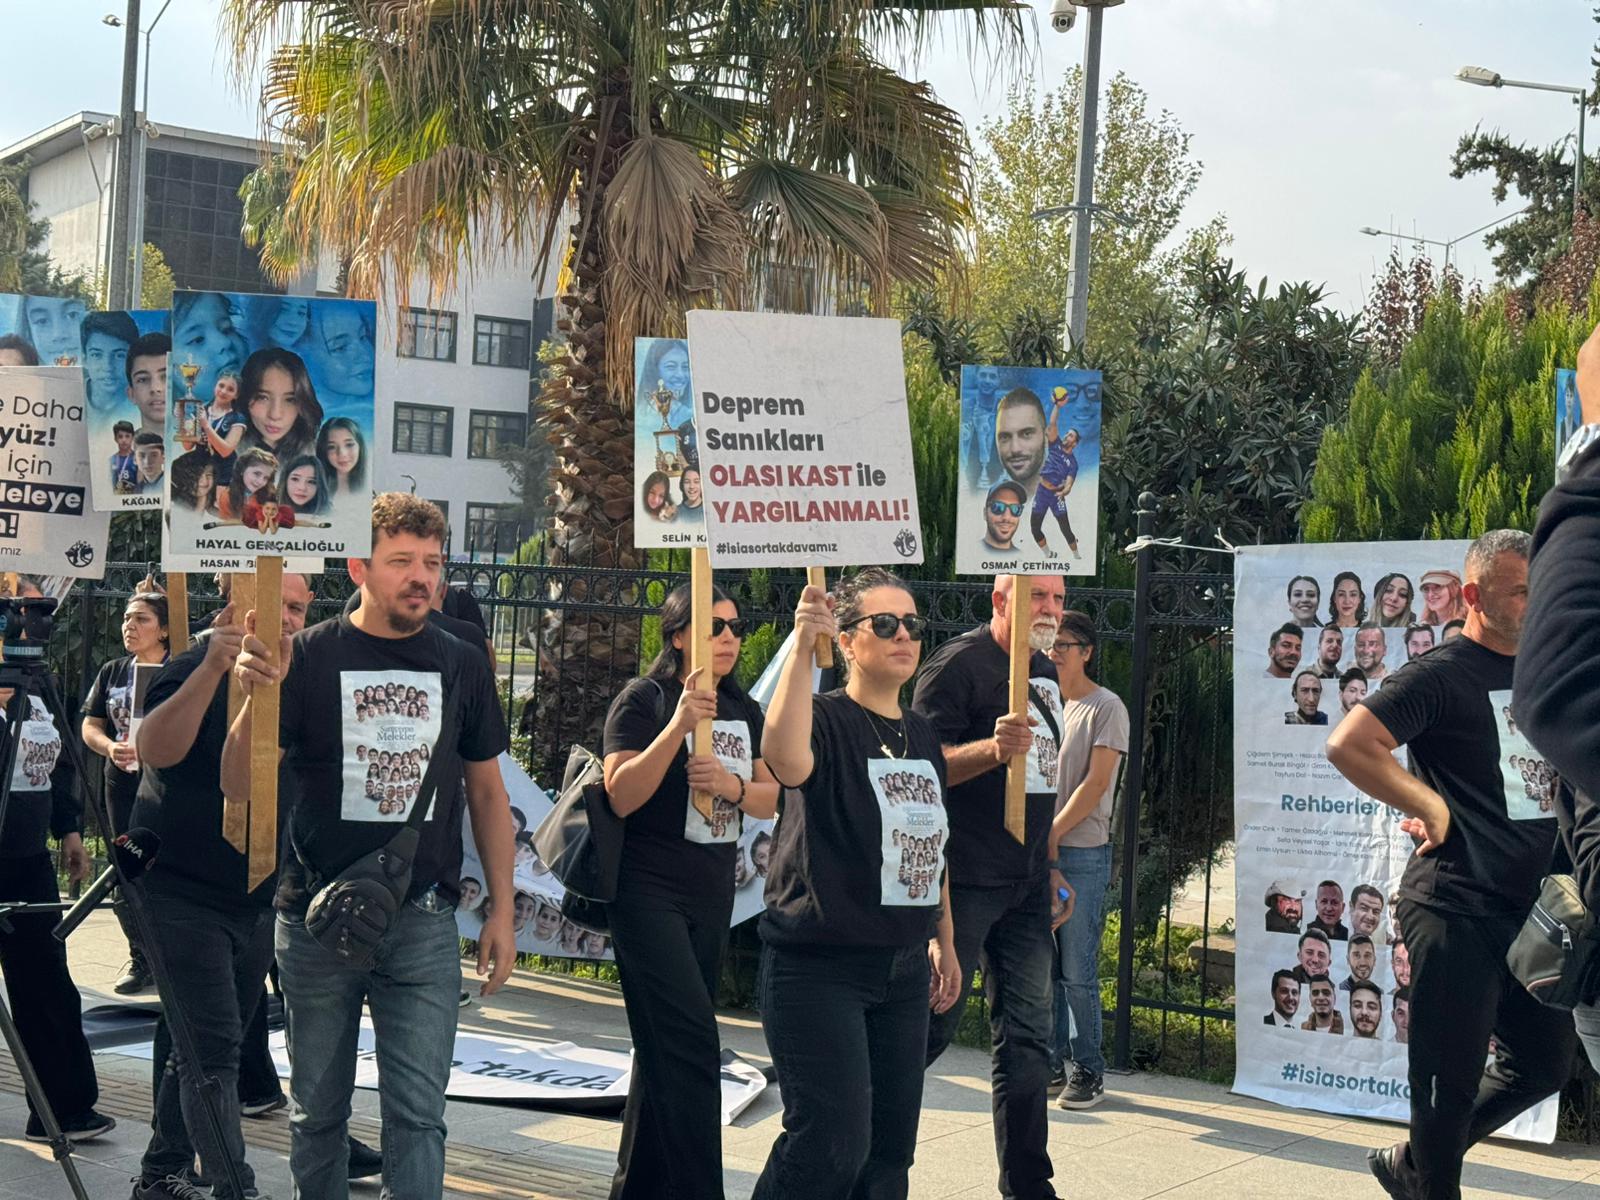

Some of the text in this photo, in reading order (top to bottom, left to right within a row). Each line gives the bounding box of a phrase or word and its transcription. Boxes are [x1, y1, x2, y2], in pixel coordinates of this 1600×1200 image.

[13, 396, 84, 422] Daha
[702, 391, 805, 422] Deprem
[705, 427, 825, 451] Sanıkları
[8, 449, 52, 480] İçin
[709, 462, 887, 487] OLASI KAST ile
[711, 499, 911, 523] YARGILANMALI!
[195, 539, 345, 553] HAYAL GENÇALİOĞLU
[662, 530, 692, 543] SELİN
[716, 542, 838, 555] #isiasortakdavamız
[200, 559, 240, 568] HASAN
[981, 559, 1071, 572] OSMAN ÇETİNTAŞ
[1280, 794, 1381, 815] Rehberler
